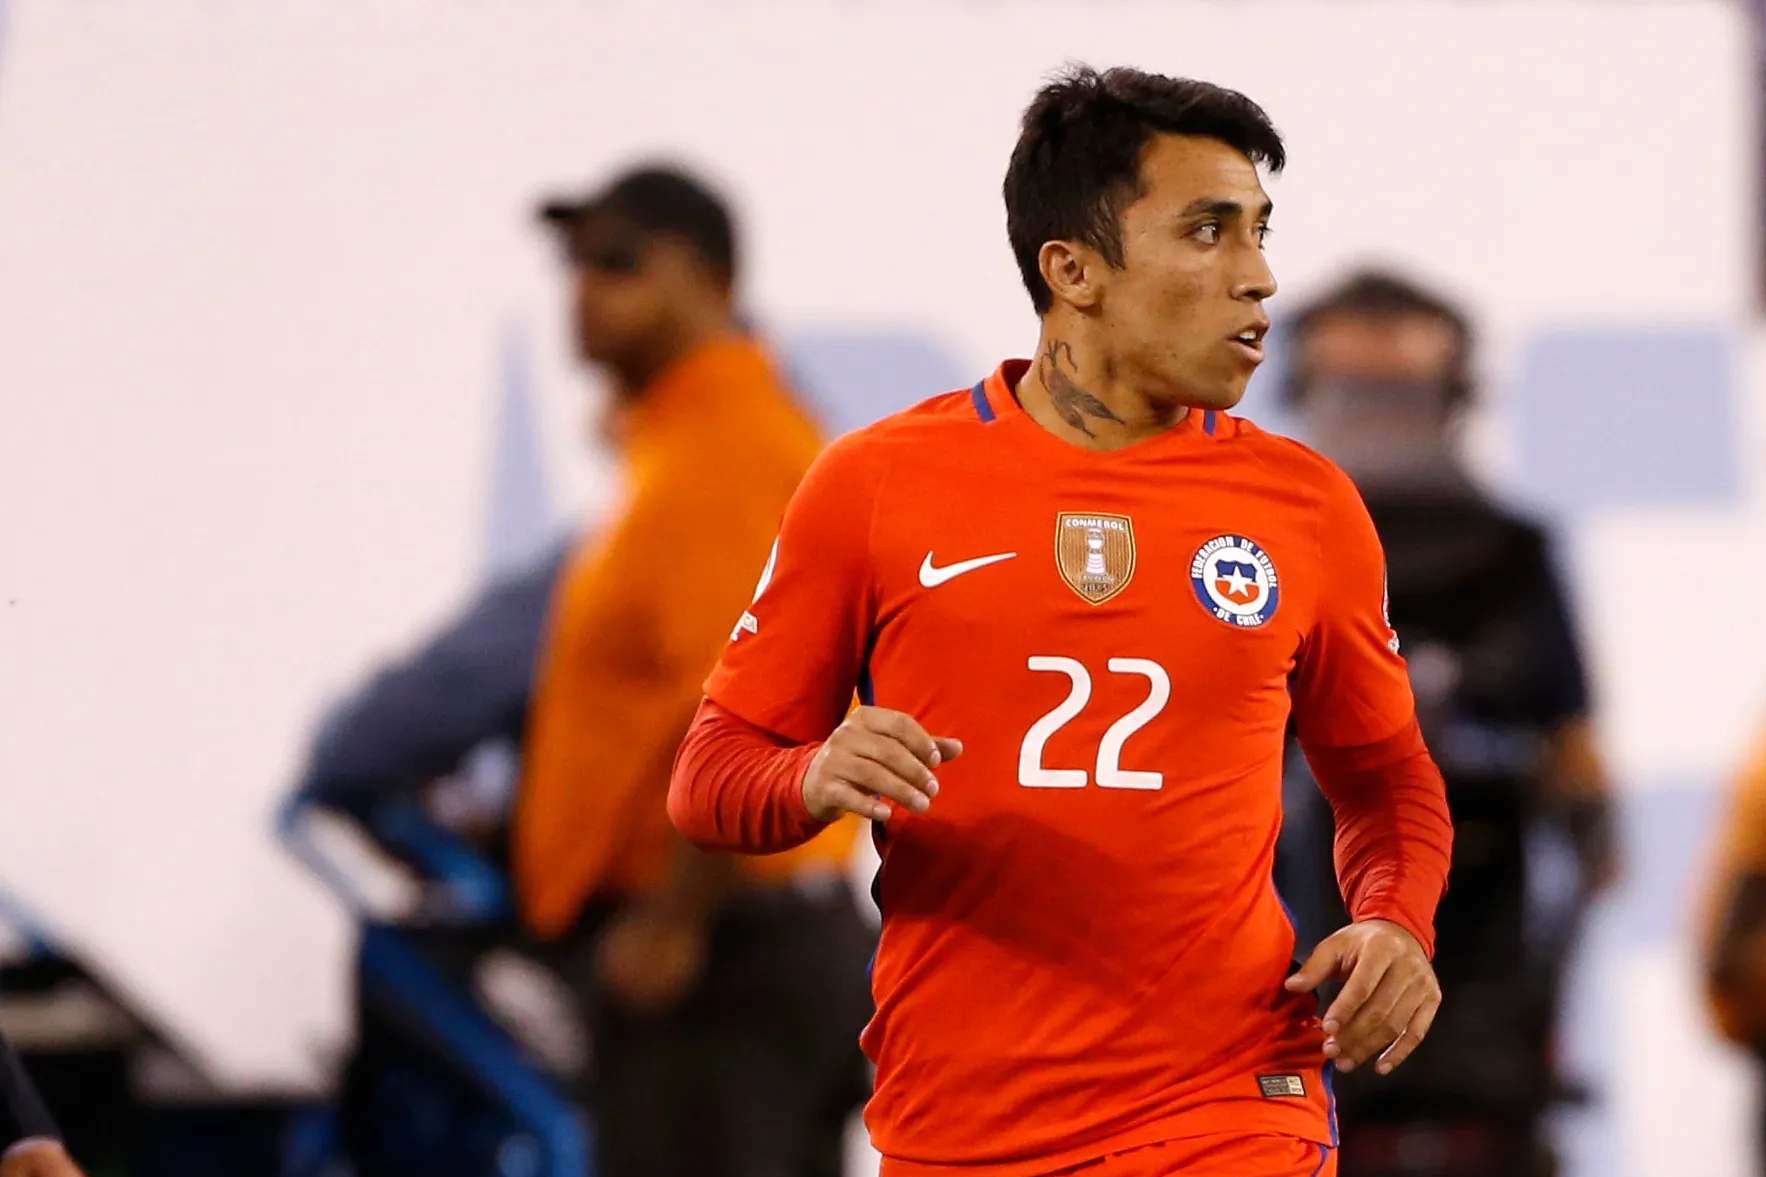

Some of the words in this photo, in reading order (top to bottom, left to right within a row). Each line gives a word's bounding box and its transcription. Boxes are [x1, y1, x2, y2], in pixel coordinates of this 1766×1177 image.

[1065, 518, 1125, 531] CONMEBOL
[1240, 538, 1255, 553] DE
[1255, 550, 1278, 588] FUTBOL
[1216, 607, 1231, 623] DE
[1018, 655, 1171, 791] 22
